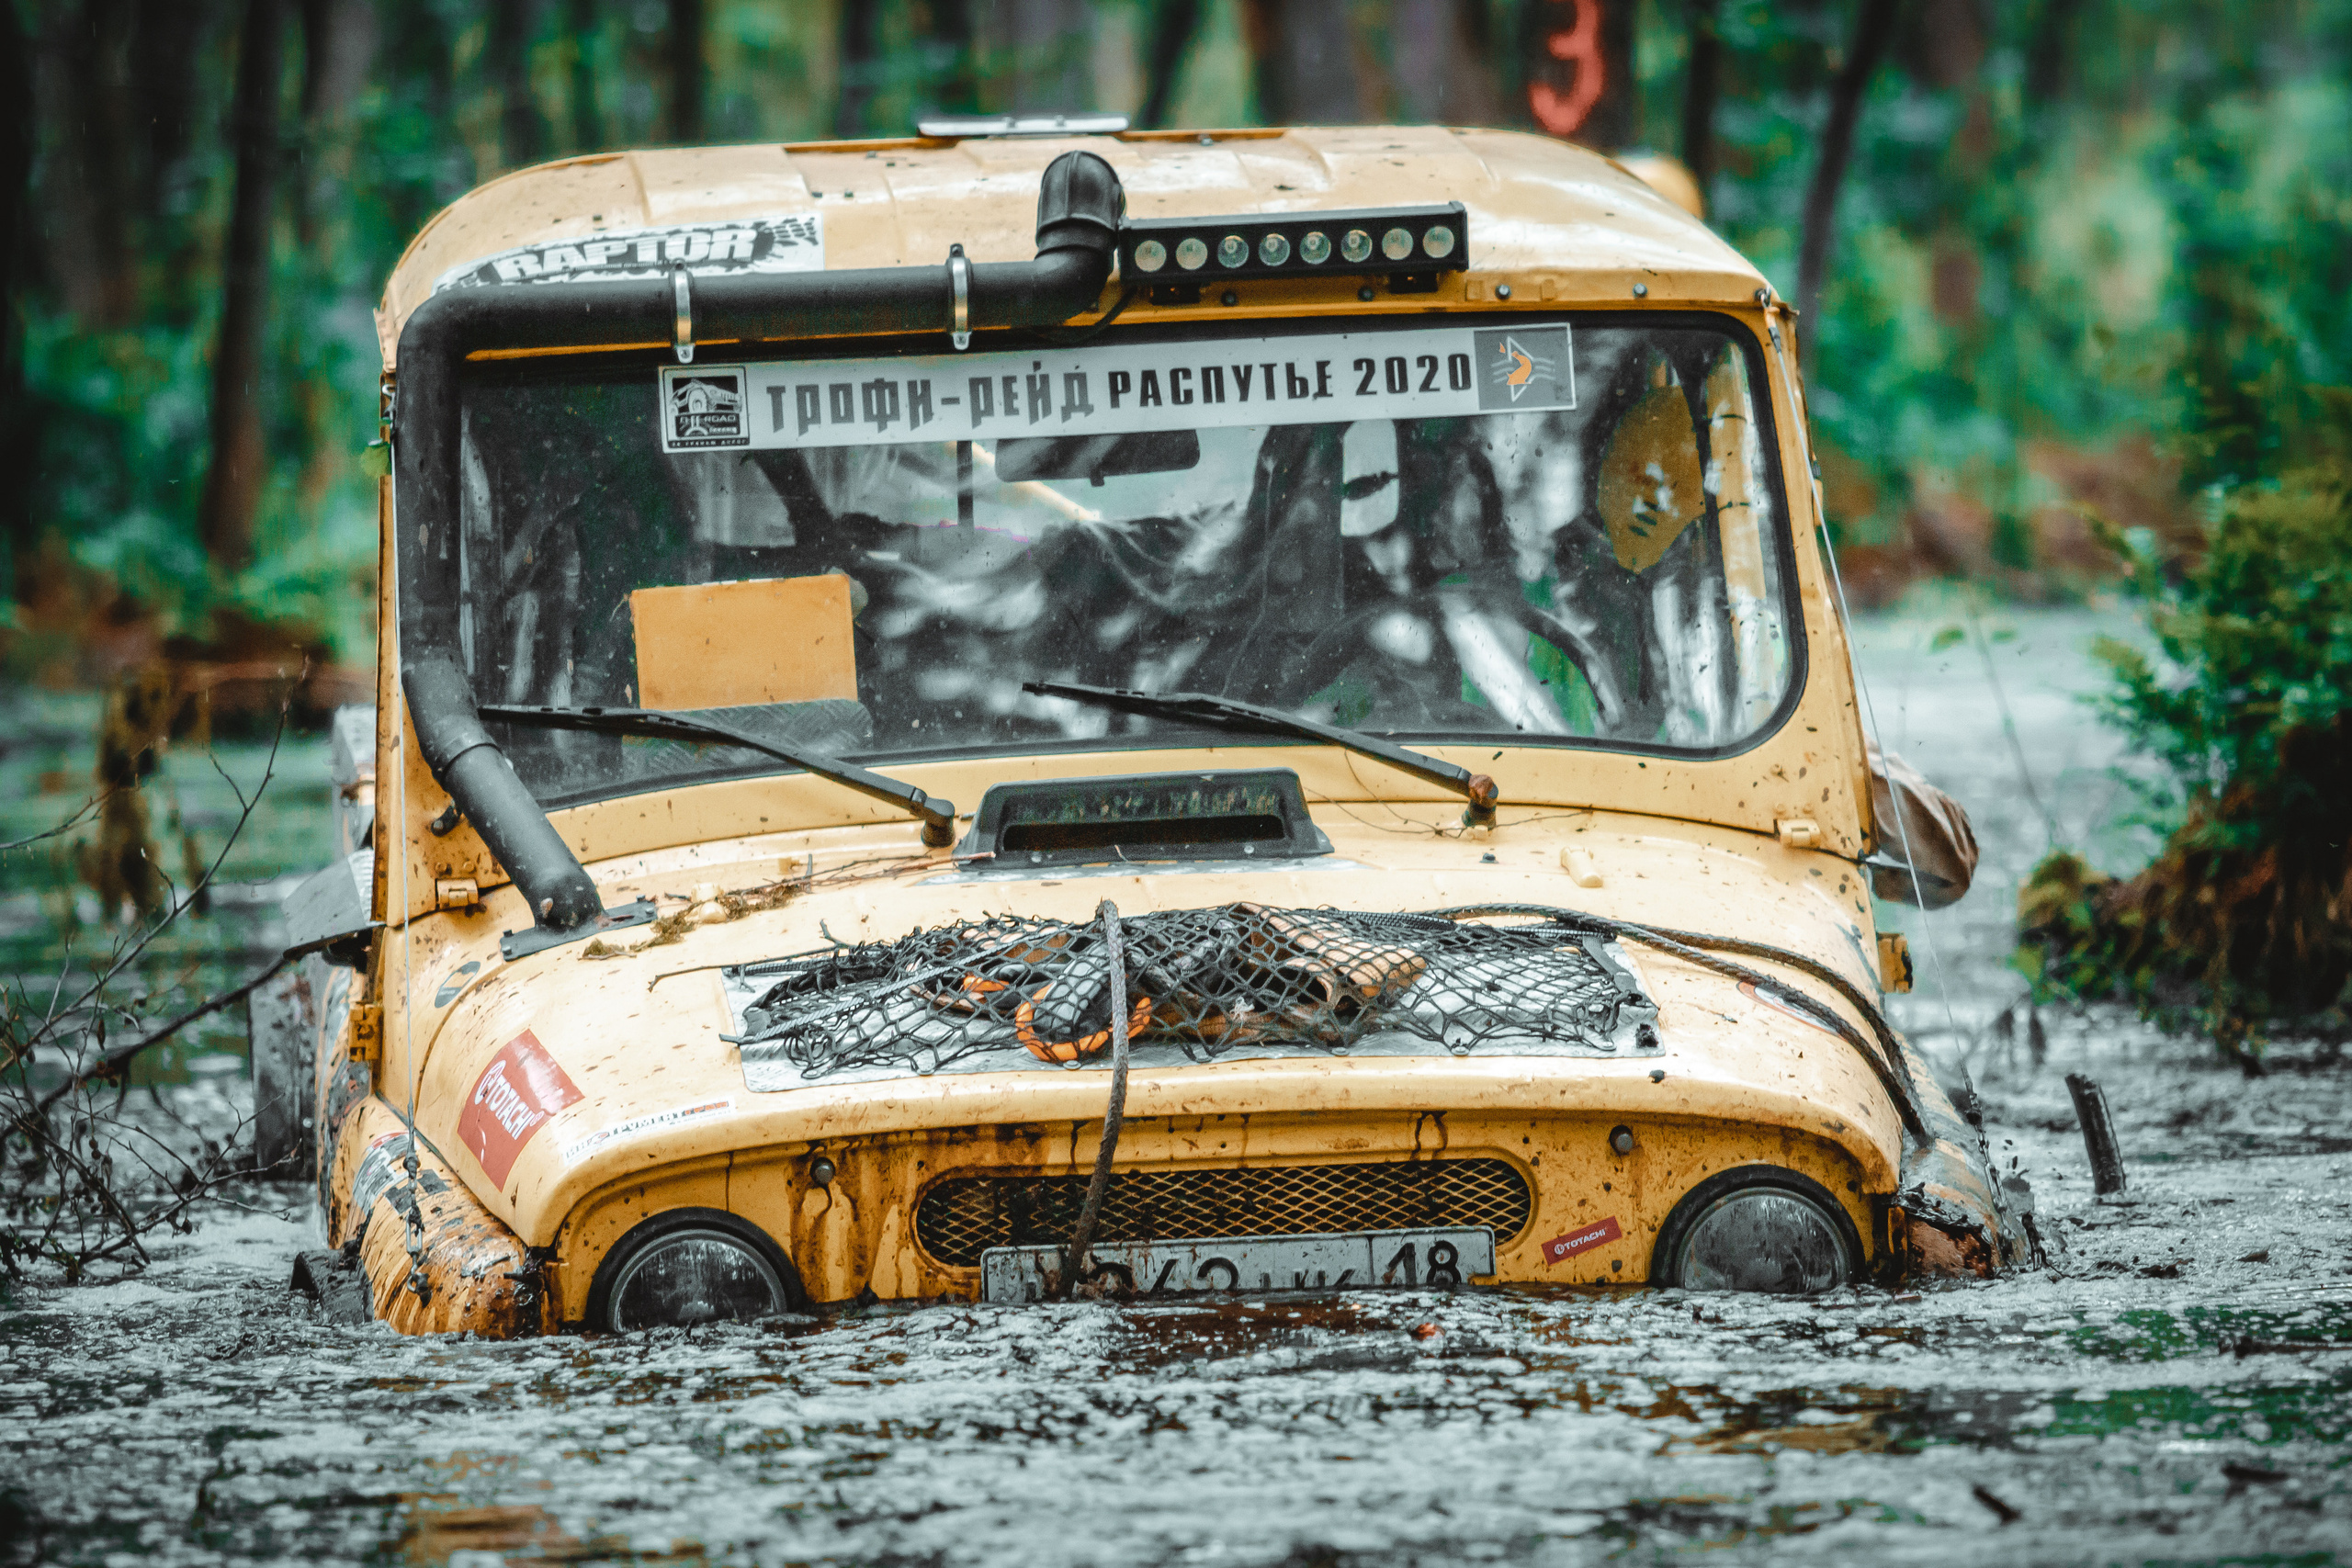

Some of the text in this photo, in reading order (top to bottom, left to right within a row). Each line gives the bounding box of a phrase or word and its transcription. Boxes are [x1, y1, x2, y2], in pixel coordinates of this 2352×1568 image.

[491, 228, 758, 283] RAPTOR
[765, 353, 1472, 437] ТРОФИ-РЕЙД РАСПУТЬЕ 2020
[484, 1073, 536, 1141] TOTACHI
[1564, 1228, 1607, 1250] TOTACHI
